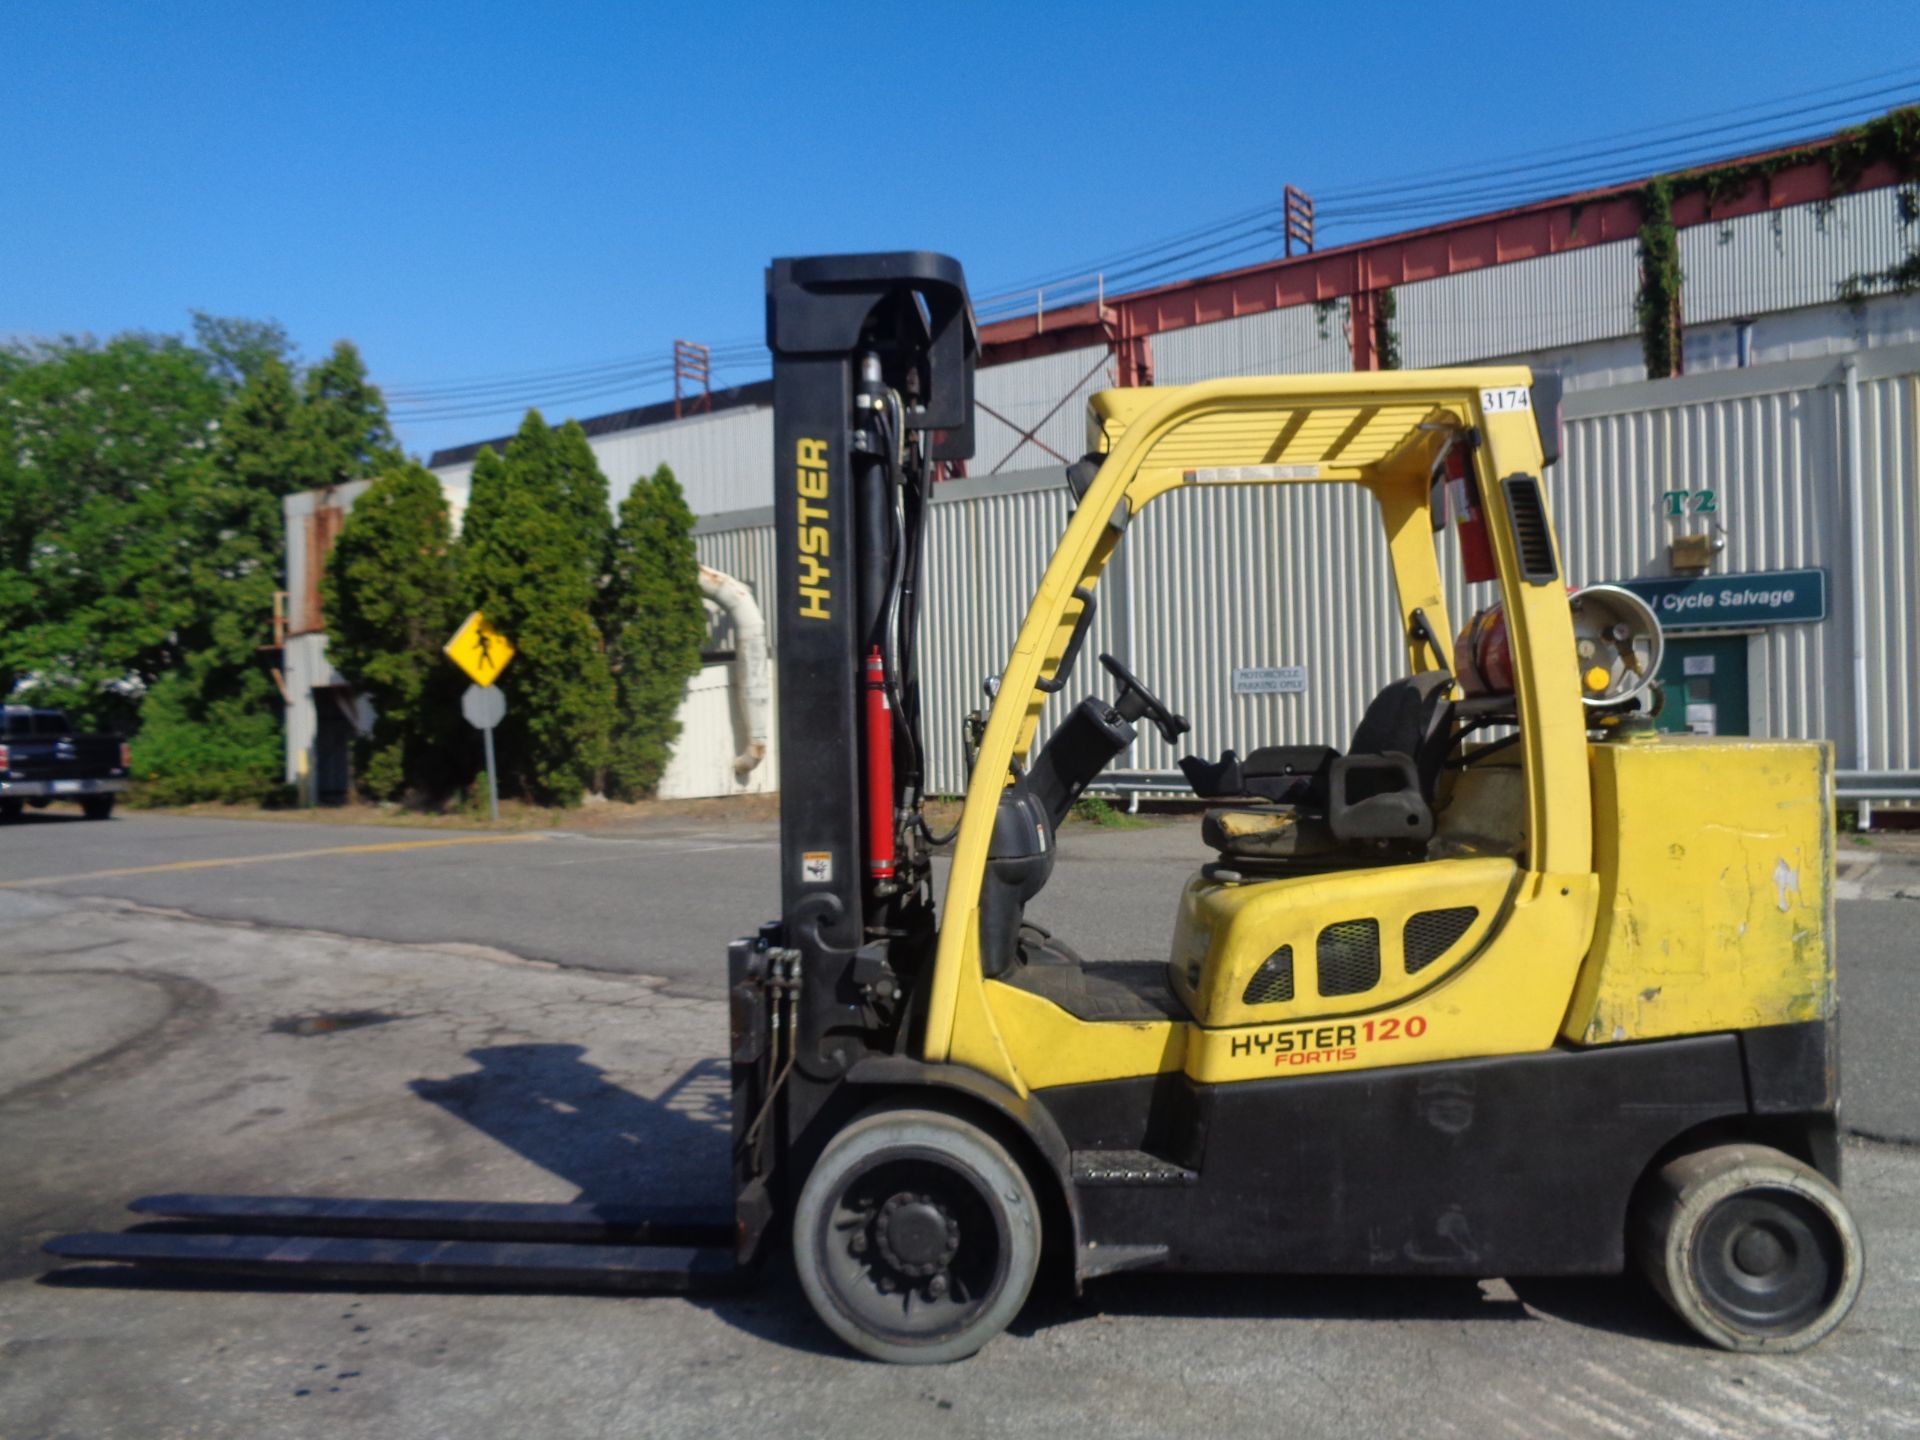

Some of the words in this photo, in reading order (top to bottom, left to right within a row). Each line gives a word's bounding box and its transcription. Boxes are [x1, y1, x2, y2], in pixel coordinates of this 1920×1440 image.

[1483, 390, 1528, 411] 3174
[796, 437, 831, 620] HYSTER
[1662, 592, 1714, 613] Cycle
[1719, 589, 1795, 608] Salvage
[1240, 669, 1299, 679] MOTORCYCLE
[1238, 681, 1277, 690] PARKING
[1280, 680, 1303, 688] ONLY
[1231, 1025, 1356, 1057] HYSTER
[1362, 1015, 1427, 1042] 120
[1275, 1047, 1357, 1067] FORTIS
